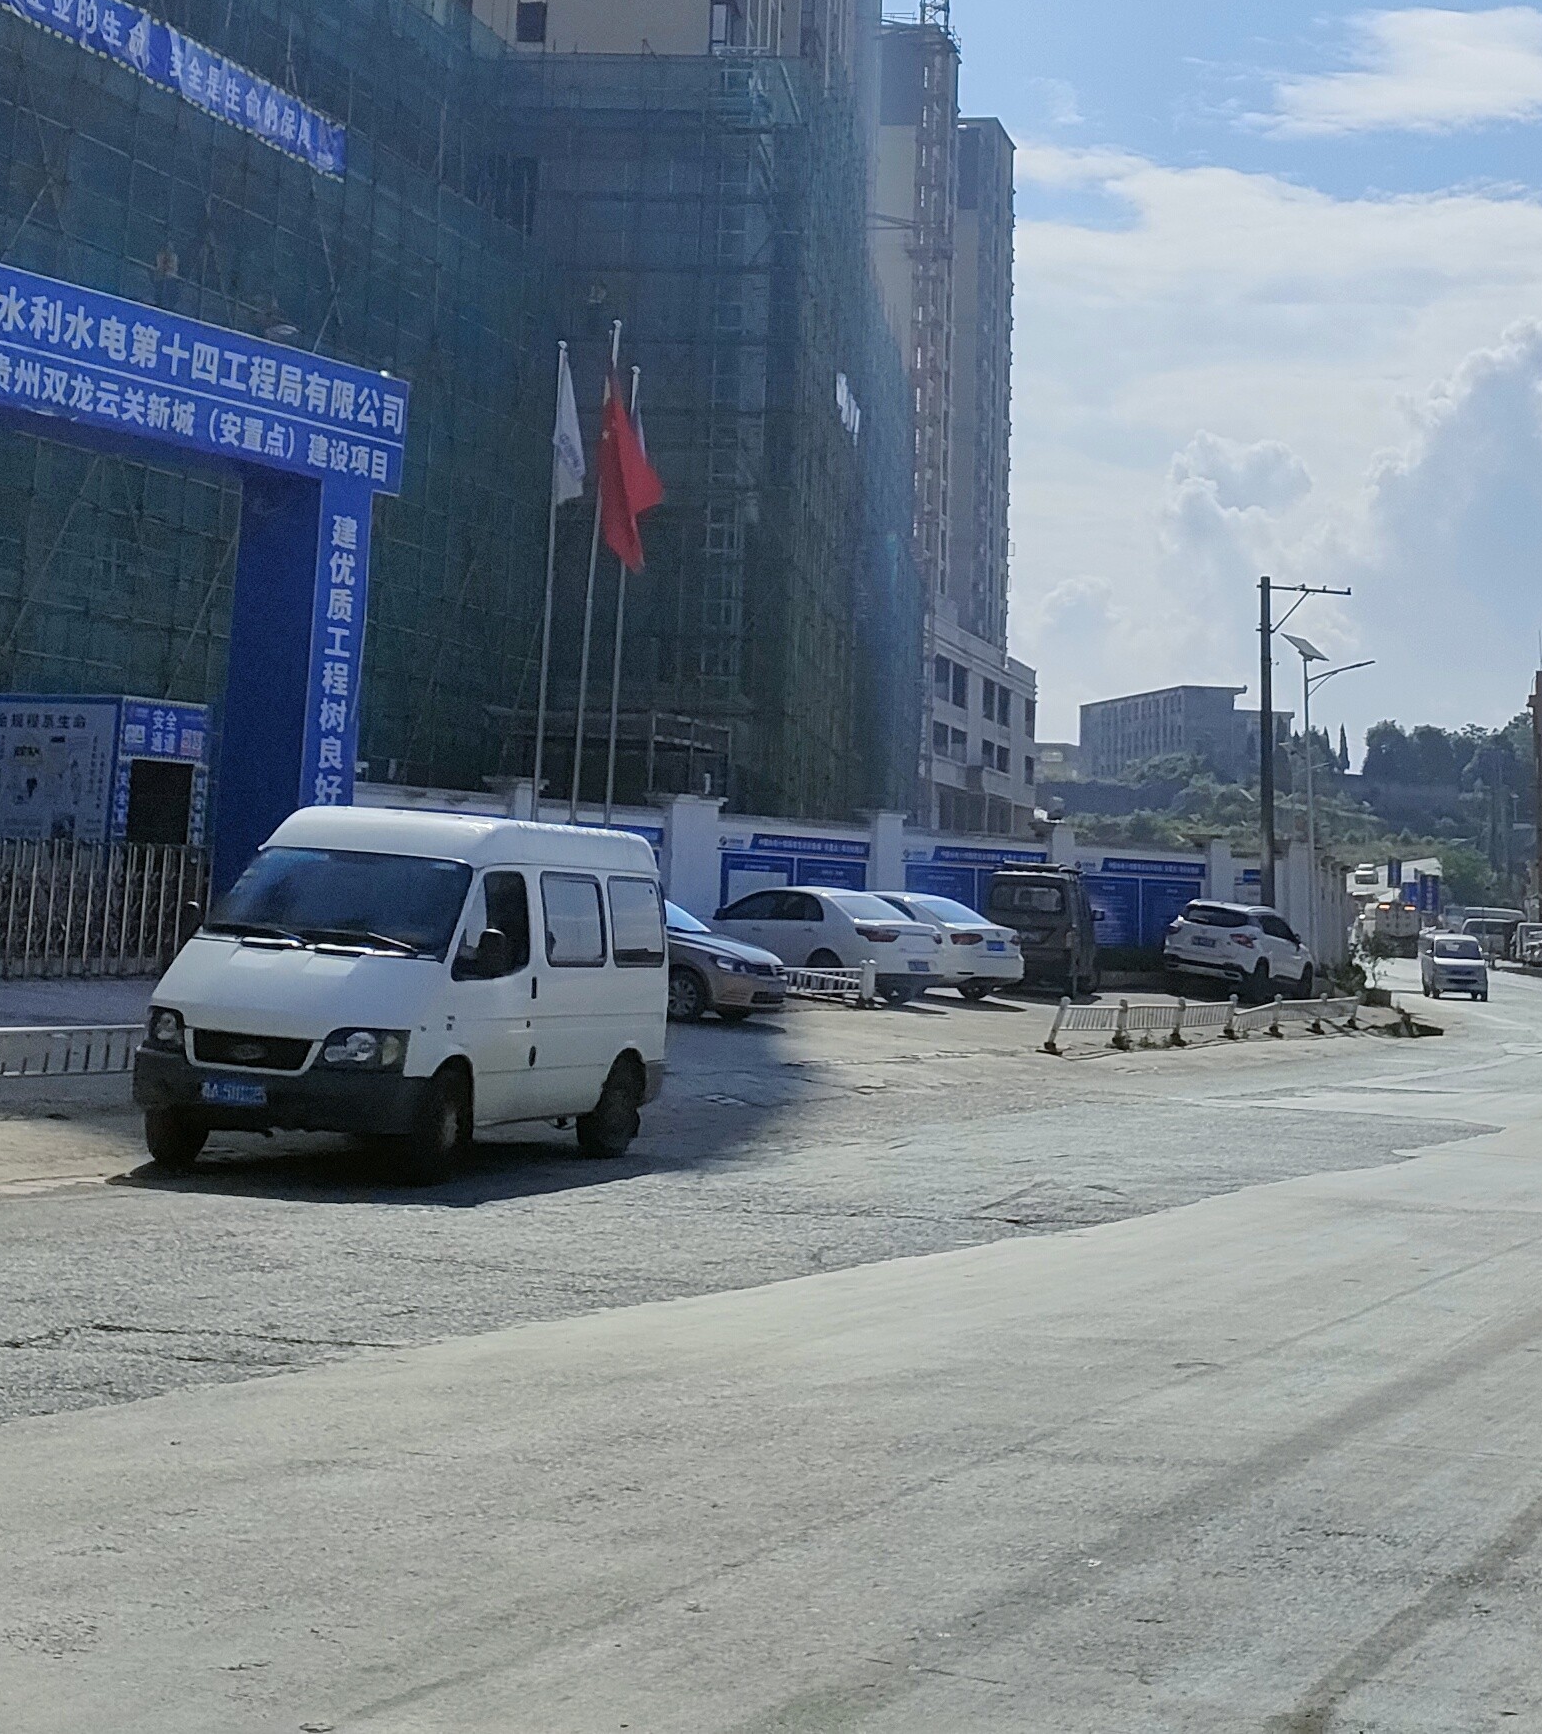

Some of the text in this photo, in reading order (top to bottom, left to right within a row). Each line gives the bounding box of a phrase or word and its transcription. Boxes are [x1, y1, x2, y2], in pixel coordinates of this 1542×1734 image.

[297, 515, 359, 807] 建优质工程树良好
